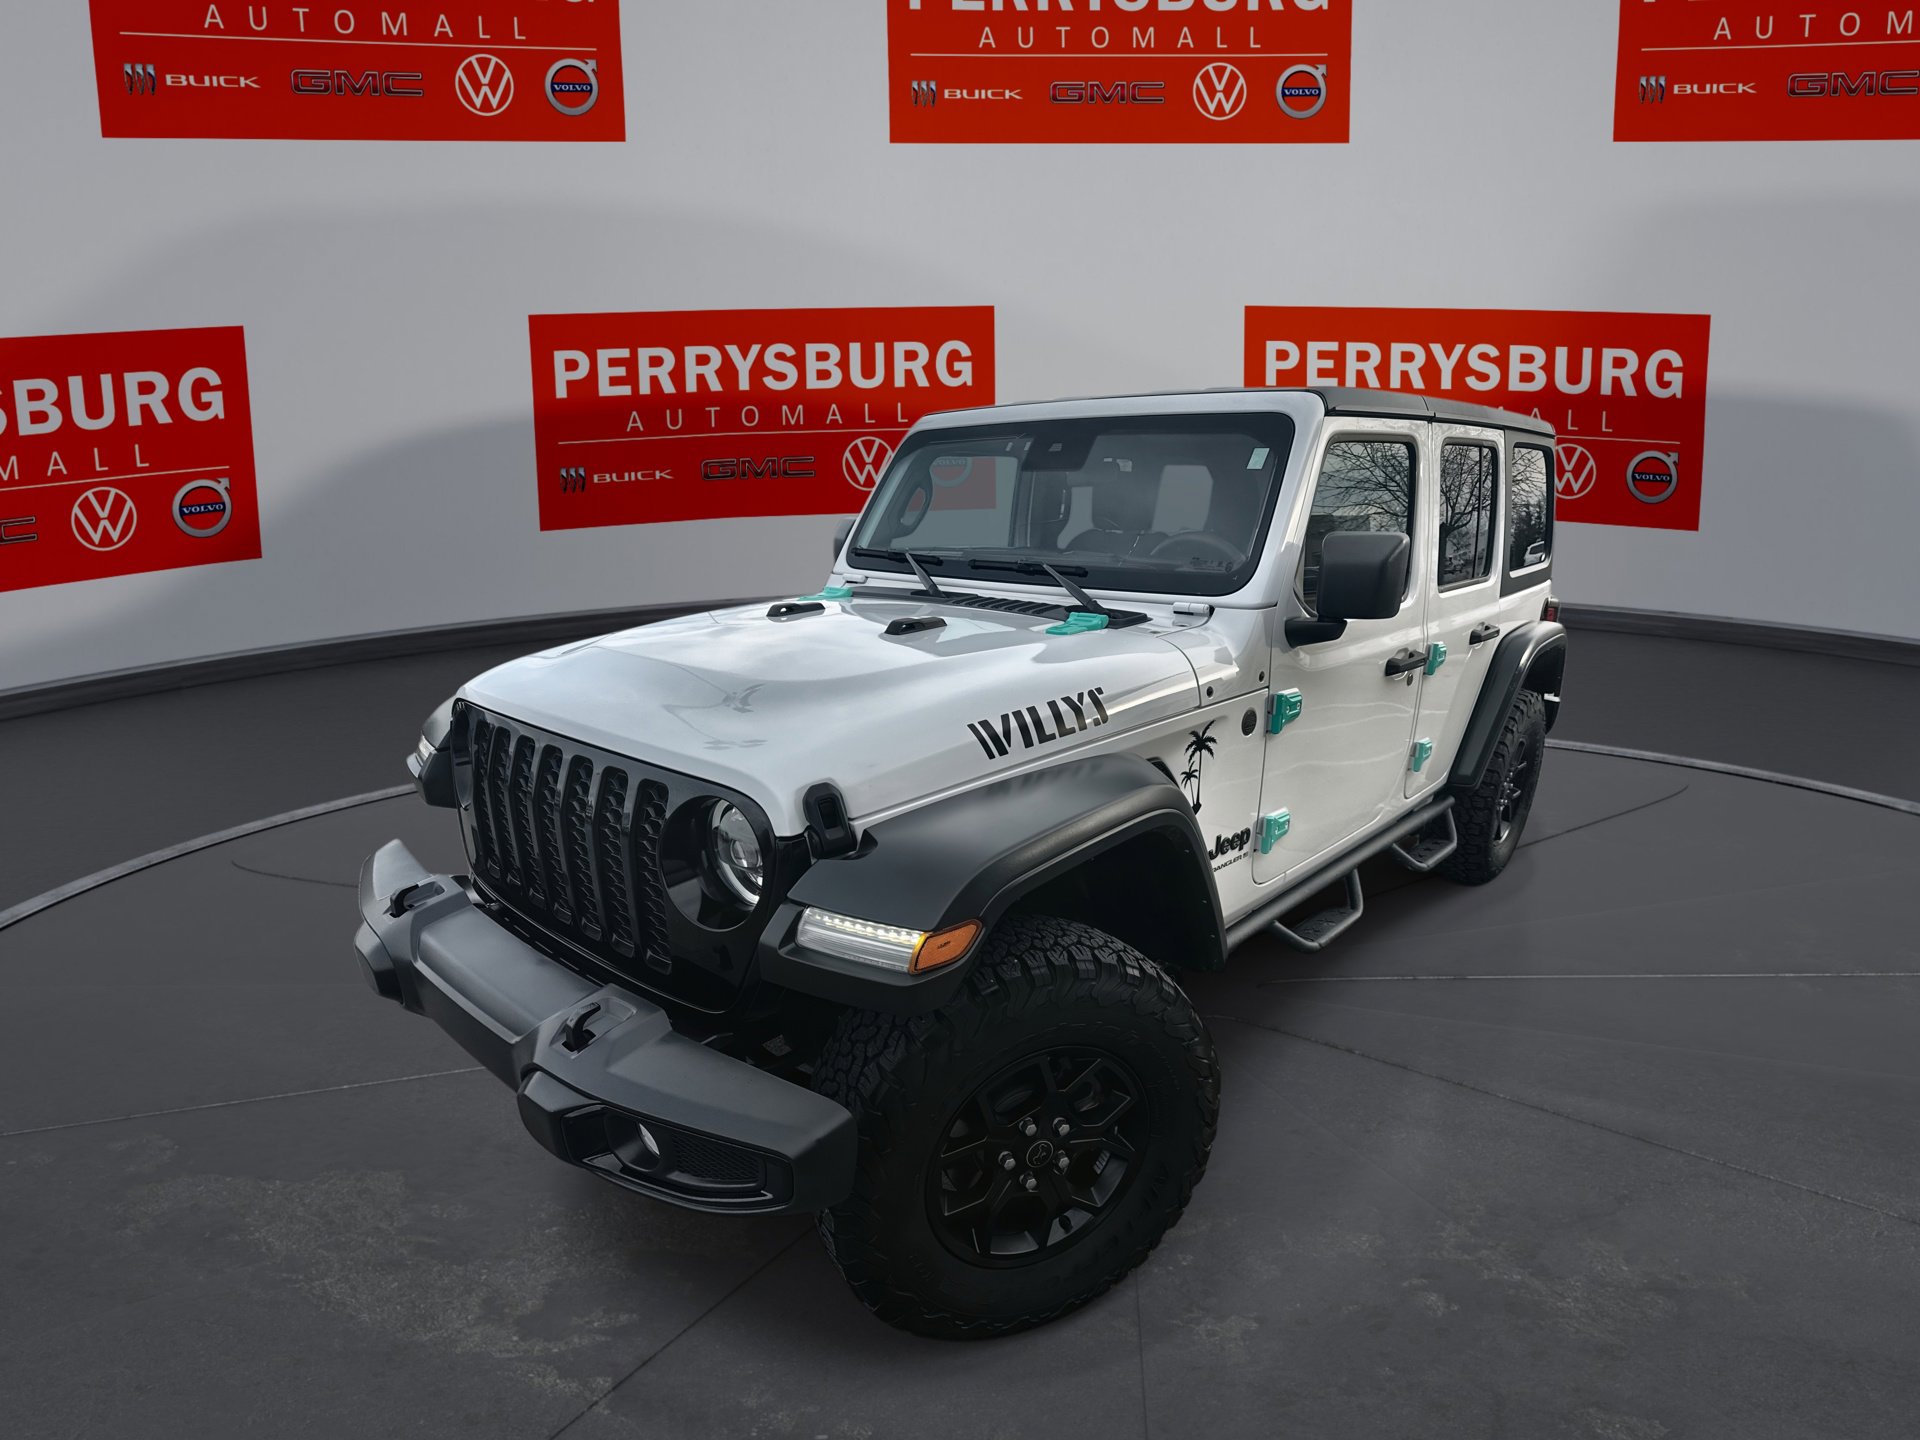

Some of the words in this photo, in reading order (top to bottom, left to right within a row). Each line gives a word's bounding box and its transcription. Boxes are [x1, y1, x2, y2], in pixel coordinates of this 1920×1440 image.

[203, 4, 527, 40] AUTOMALL
[978, 26, 1262, 49] AUTOMALL
[165, 74, 260, 89] BUICK
[290, 68, 424, 97] GMC
[553, 84, 591, 92] VOLVO
[943, 88, 1023, 100] BUICK
[1049, 80, 1165, 104] GMC
[1283, 88, 1319, 96] VOLVO
[1673, 82, 1757, 95] BUICK
[1787, 70, 1920, 98] GMC
[553, 339, 973, 400] PERRYSBURG
[1264, 340, 1684, 399] PERRYSBURG
[0, 366, 225, 437] BURG
[625, 402, 909, 433] AUTOMALL
[593, 469, 674, 484] BUICK
[700, 456, 816, 480] GMC
[1634, 473, 1670, 482] VOLVO
[181, 503, 224, 514] VOLVO
[966, 686, 1109, 760] WILLYS
[1208, 826, 1251, 860] Jeep
